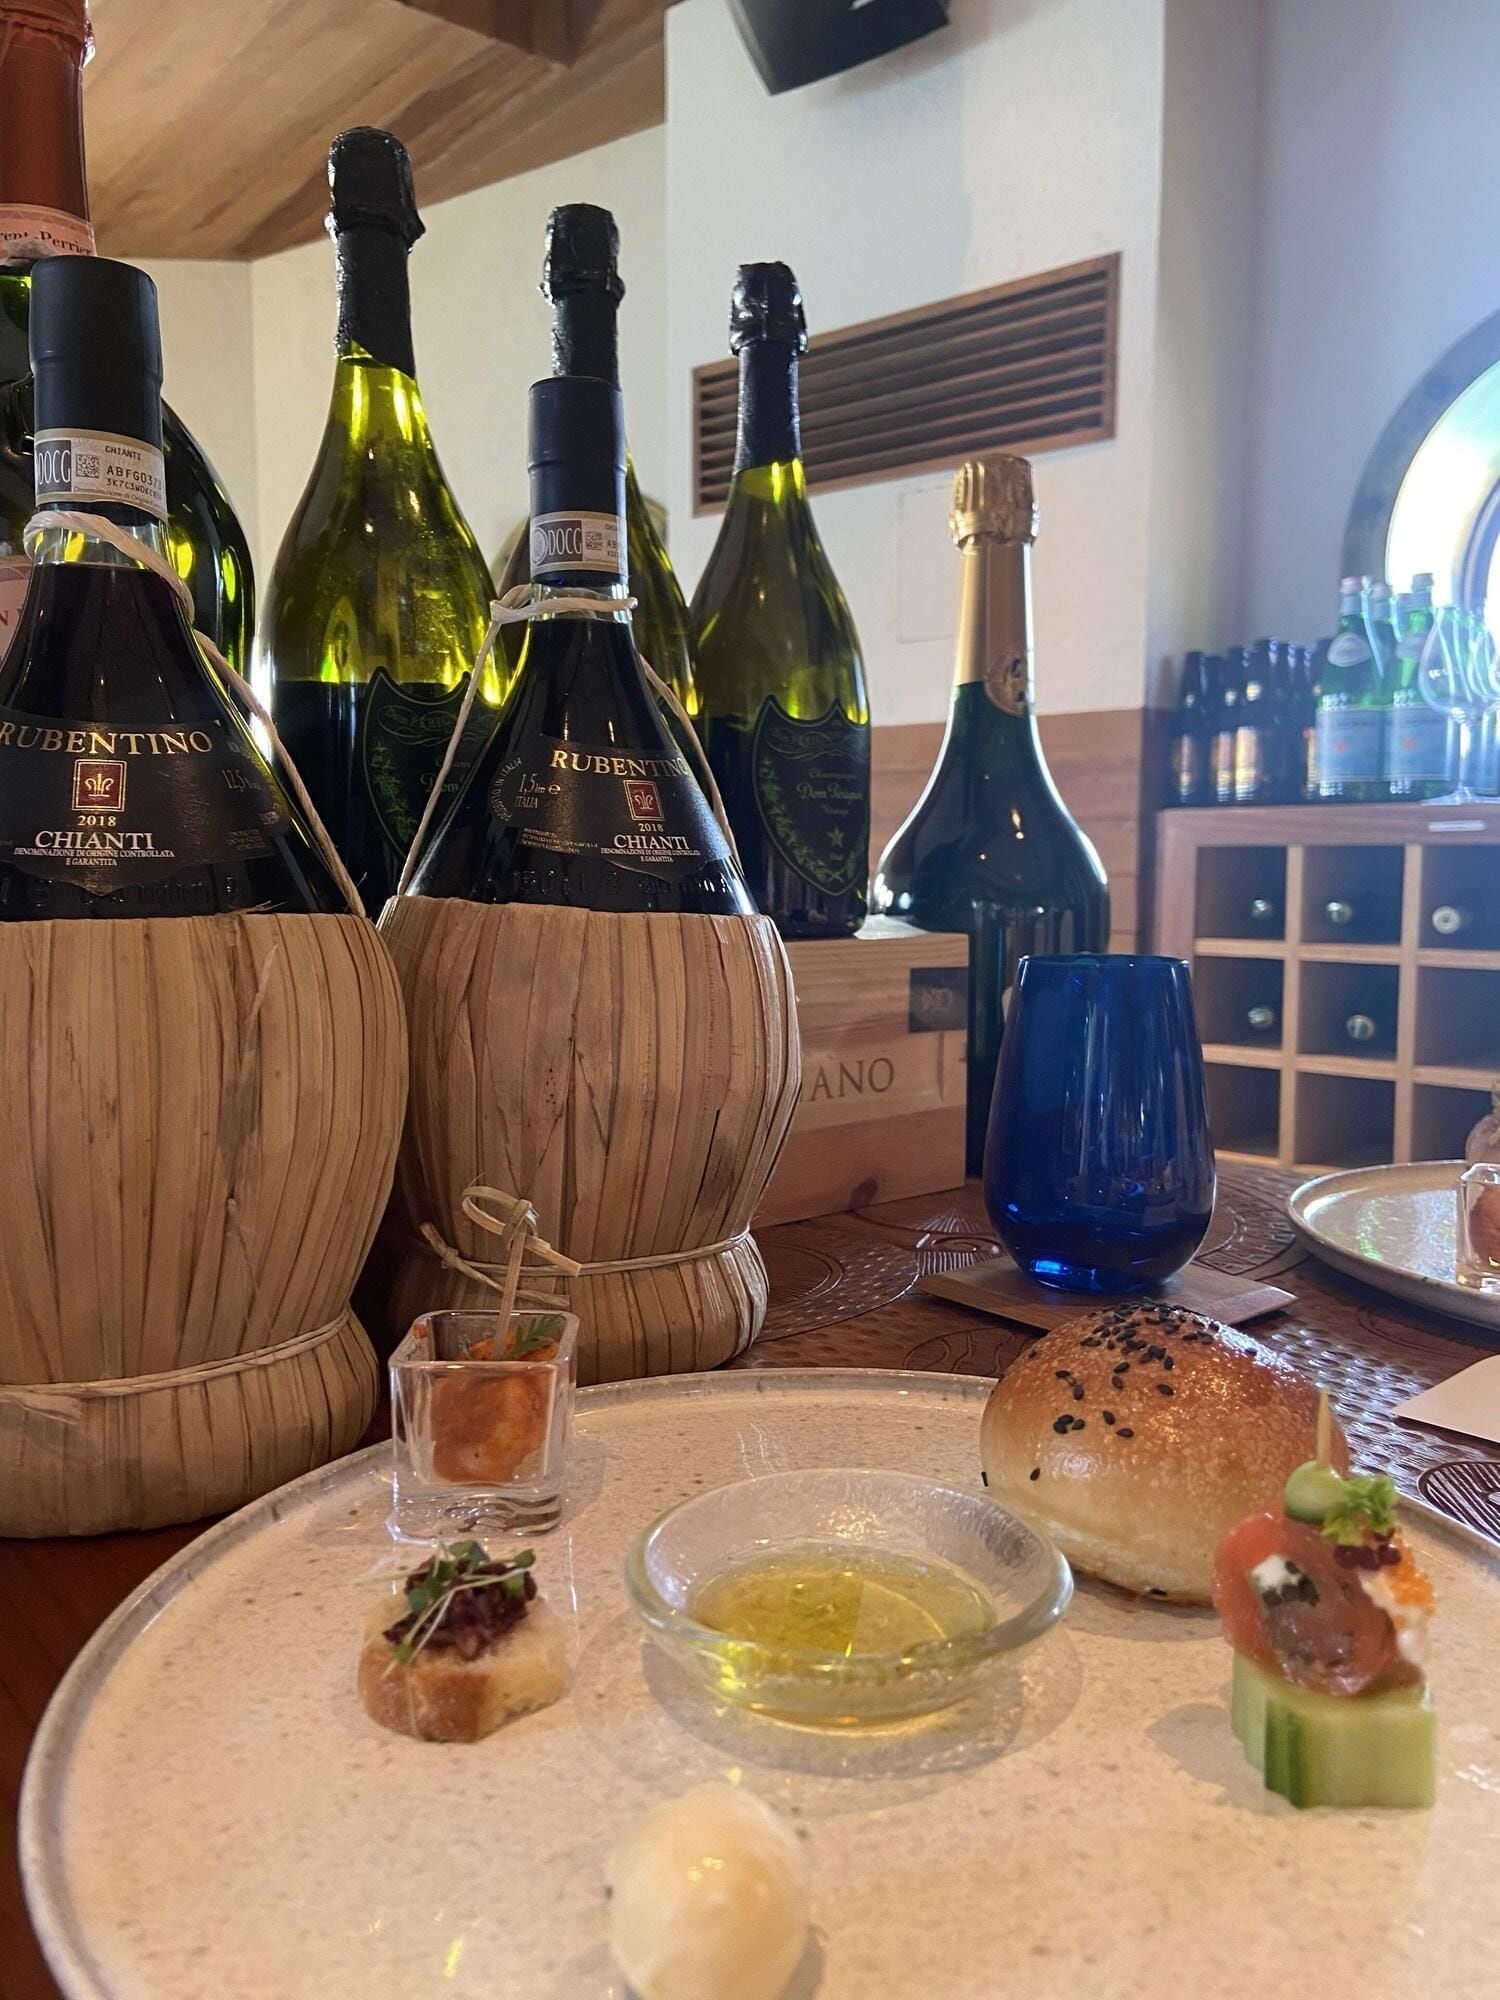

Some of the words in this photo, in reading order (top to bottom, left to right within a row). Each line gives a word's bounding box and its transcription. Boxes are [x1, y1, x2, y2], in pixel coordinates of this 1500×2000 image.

[104, 445, 142, 461] CHIANTI
[36, 449, 71, 485] DOCG
[547, 527, 582, 556] DOCG
[0, 722, 213, 755] RUBENTINO
[549, 750, 689, 777] RUBENTINO
[514, 796, 538, 809] ITALIA
[77, 815, 117, 827] 2018
[638, 822, 664, 833] 2018
[35, 831, 155, 850] CHIANTI
[613, 834, 690, 850] CHIANTI
[72, 858, 117, 866] GARANTITA
[801, 1057, 895, 1102] ANO
